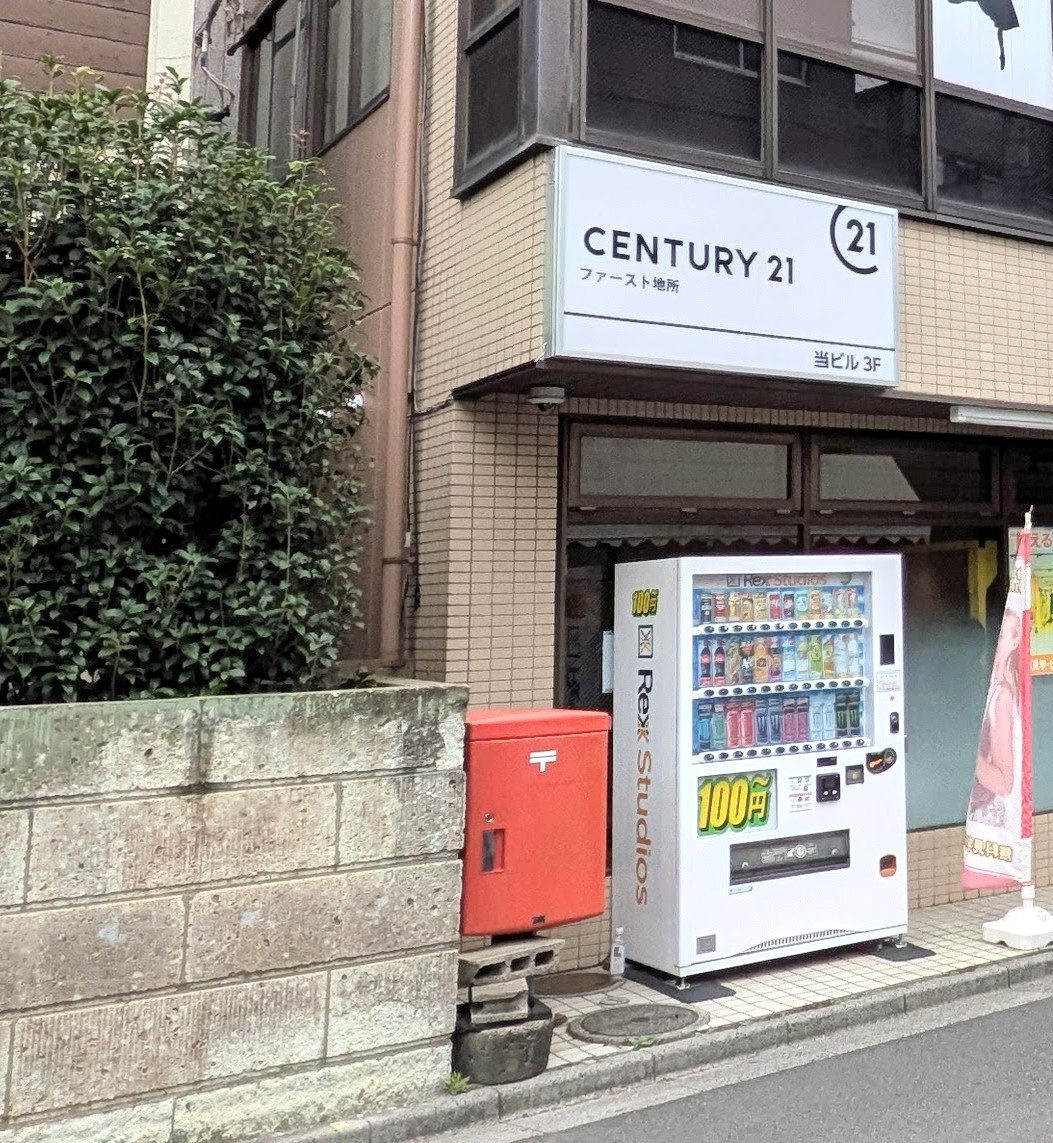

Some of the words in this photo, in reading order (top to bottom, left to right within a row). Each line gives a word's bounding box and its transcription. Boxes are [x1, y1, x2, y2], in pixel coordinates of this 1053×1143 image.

[579, 267, 681, 294] ファースト地所
[583, 226, 759, 278] CENTURY
[767, 254, 795, 285] 21
[637, 669, 654, 744] Rex
[635, 750, 654, 906] Studios
